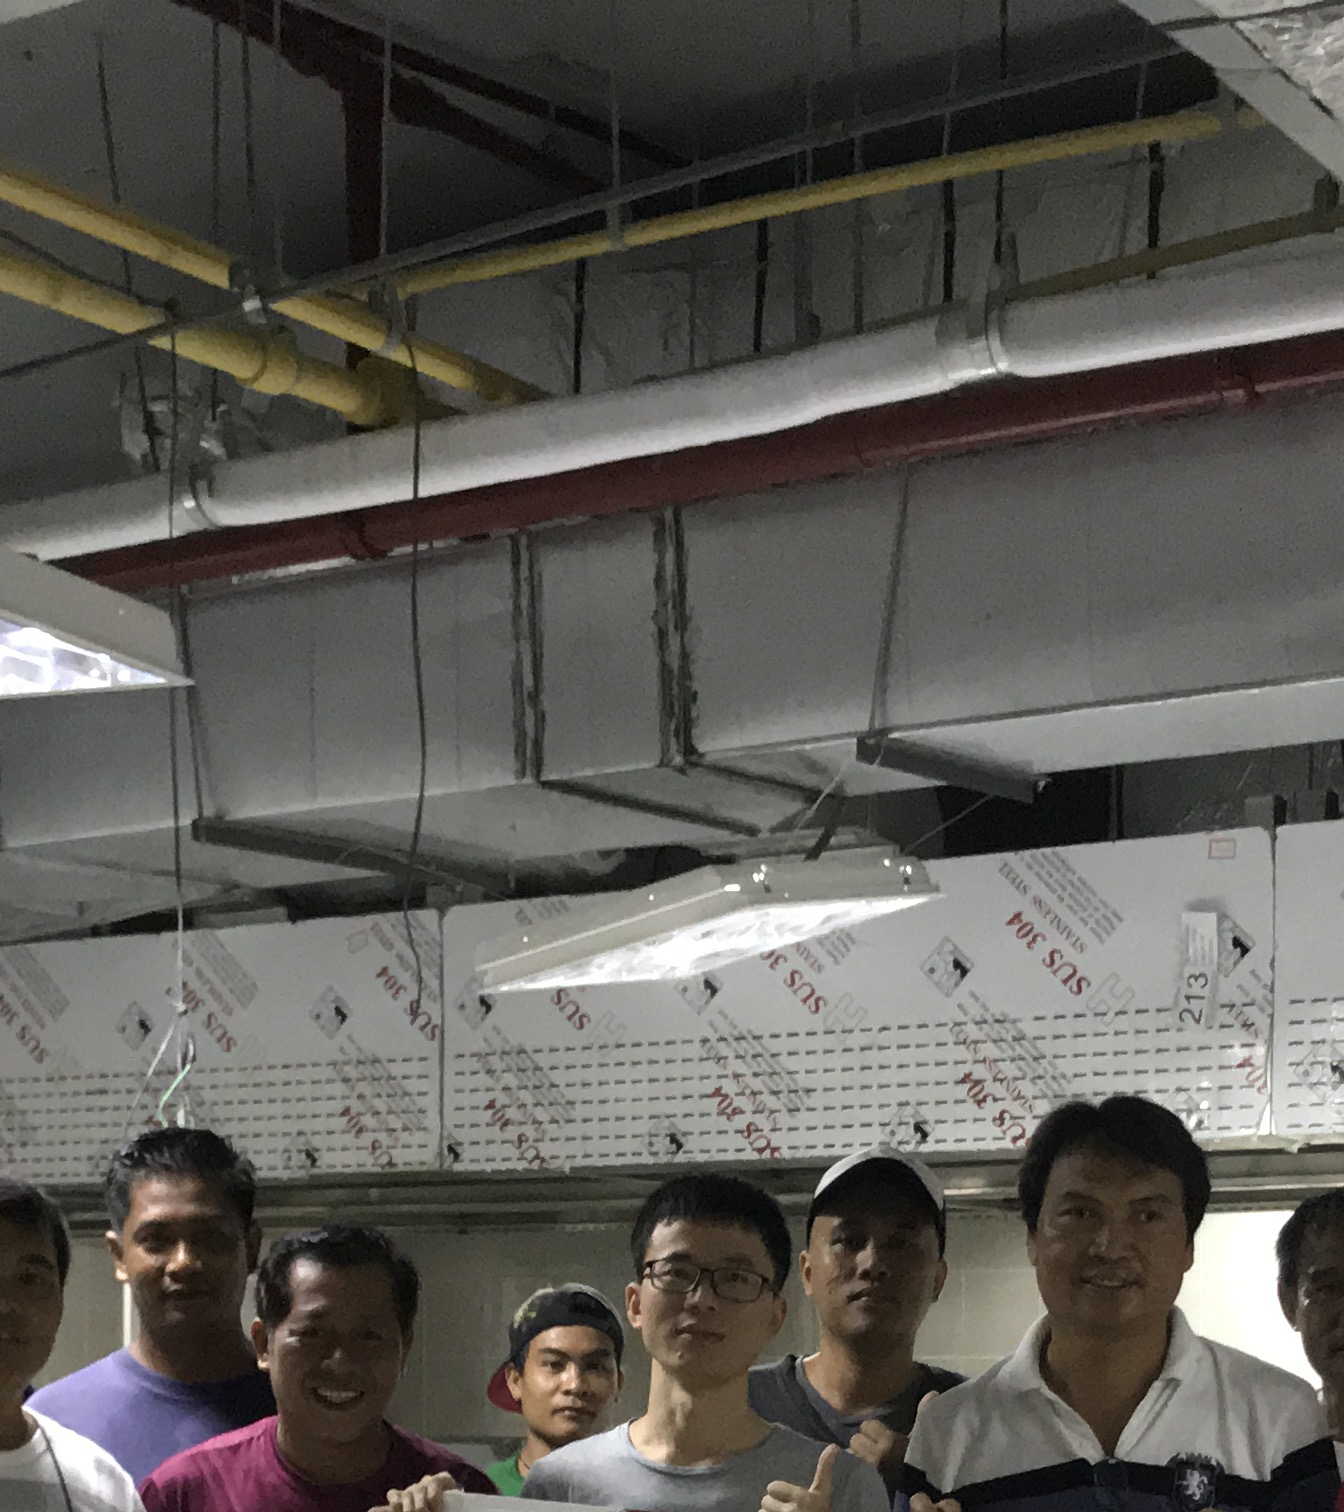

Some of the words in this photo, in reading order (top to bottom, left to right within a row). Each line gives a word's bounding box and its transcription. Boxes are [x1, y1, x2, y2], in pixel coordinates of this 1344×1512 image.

[1005, 911, 1047, 951] 304
[376, 965, 406, 1000] 304
[784, 970, 826, 1014] SUS
[1042, 948, 1091, 996] SUS
[552, 987, 591, 1031] SUS
[1178, 971, 1209, 1025] 213
[201, 1013, 238, 1053] SUS
[709, 1086, 743, 1122] 304
[961, 1071, 997, 1109] 304
